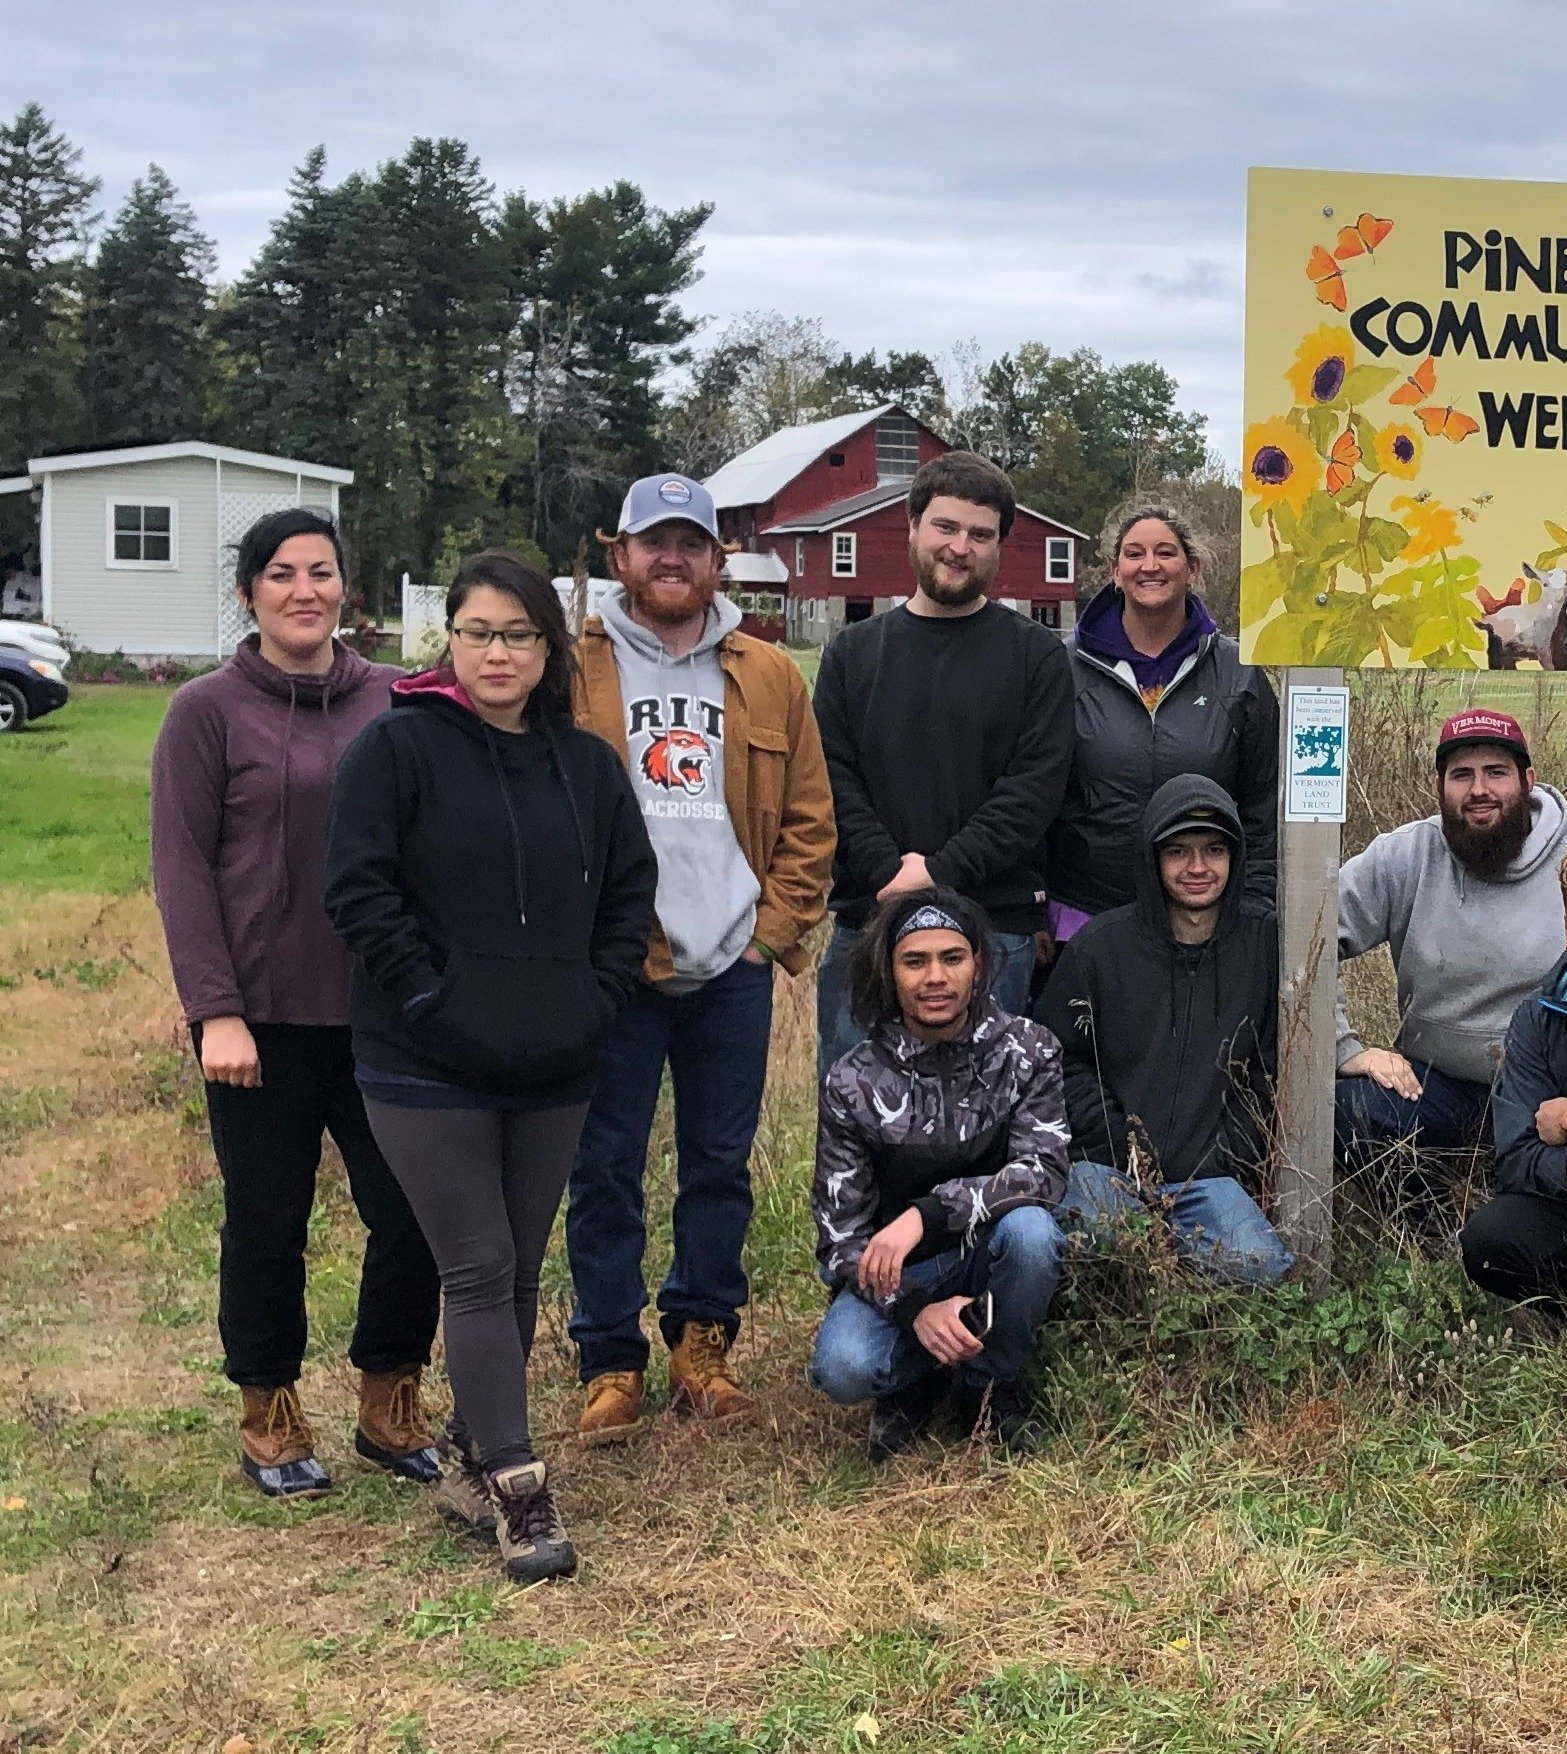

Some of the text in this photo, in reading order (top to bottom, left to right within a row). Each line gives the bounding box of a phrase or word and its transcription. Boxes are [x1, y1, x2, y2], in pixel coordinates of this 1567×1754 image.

[628, 696, 724, 741] RIT
[1452, 716, 1512, 736] VERMONT
[1302, 801, 1332, 809] TRUST
